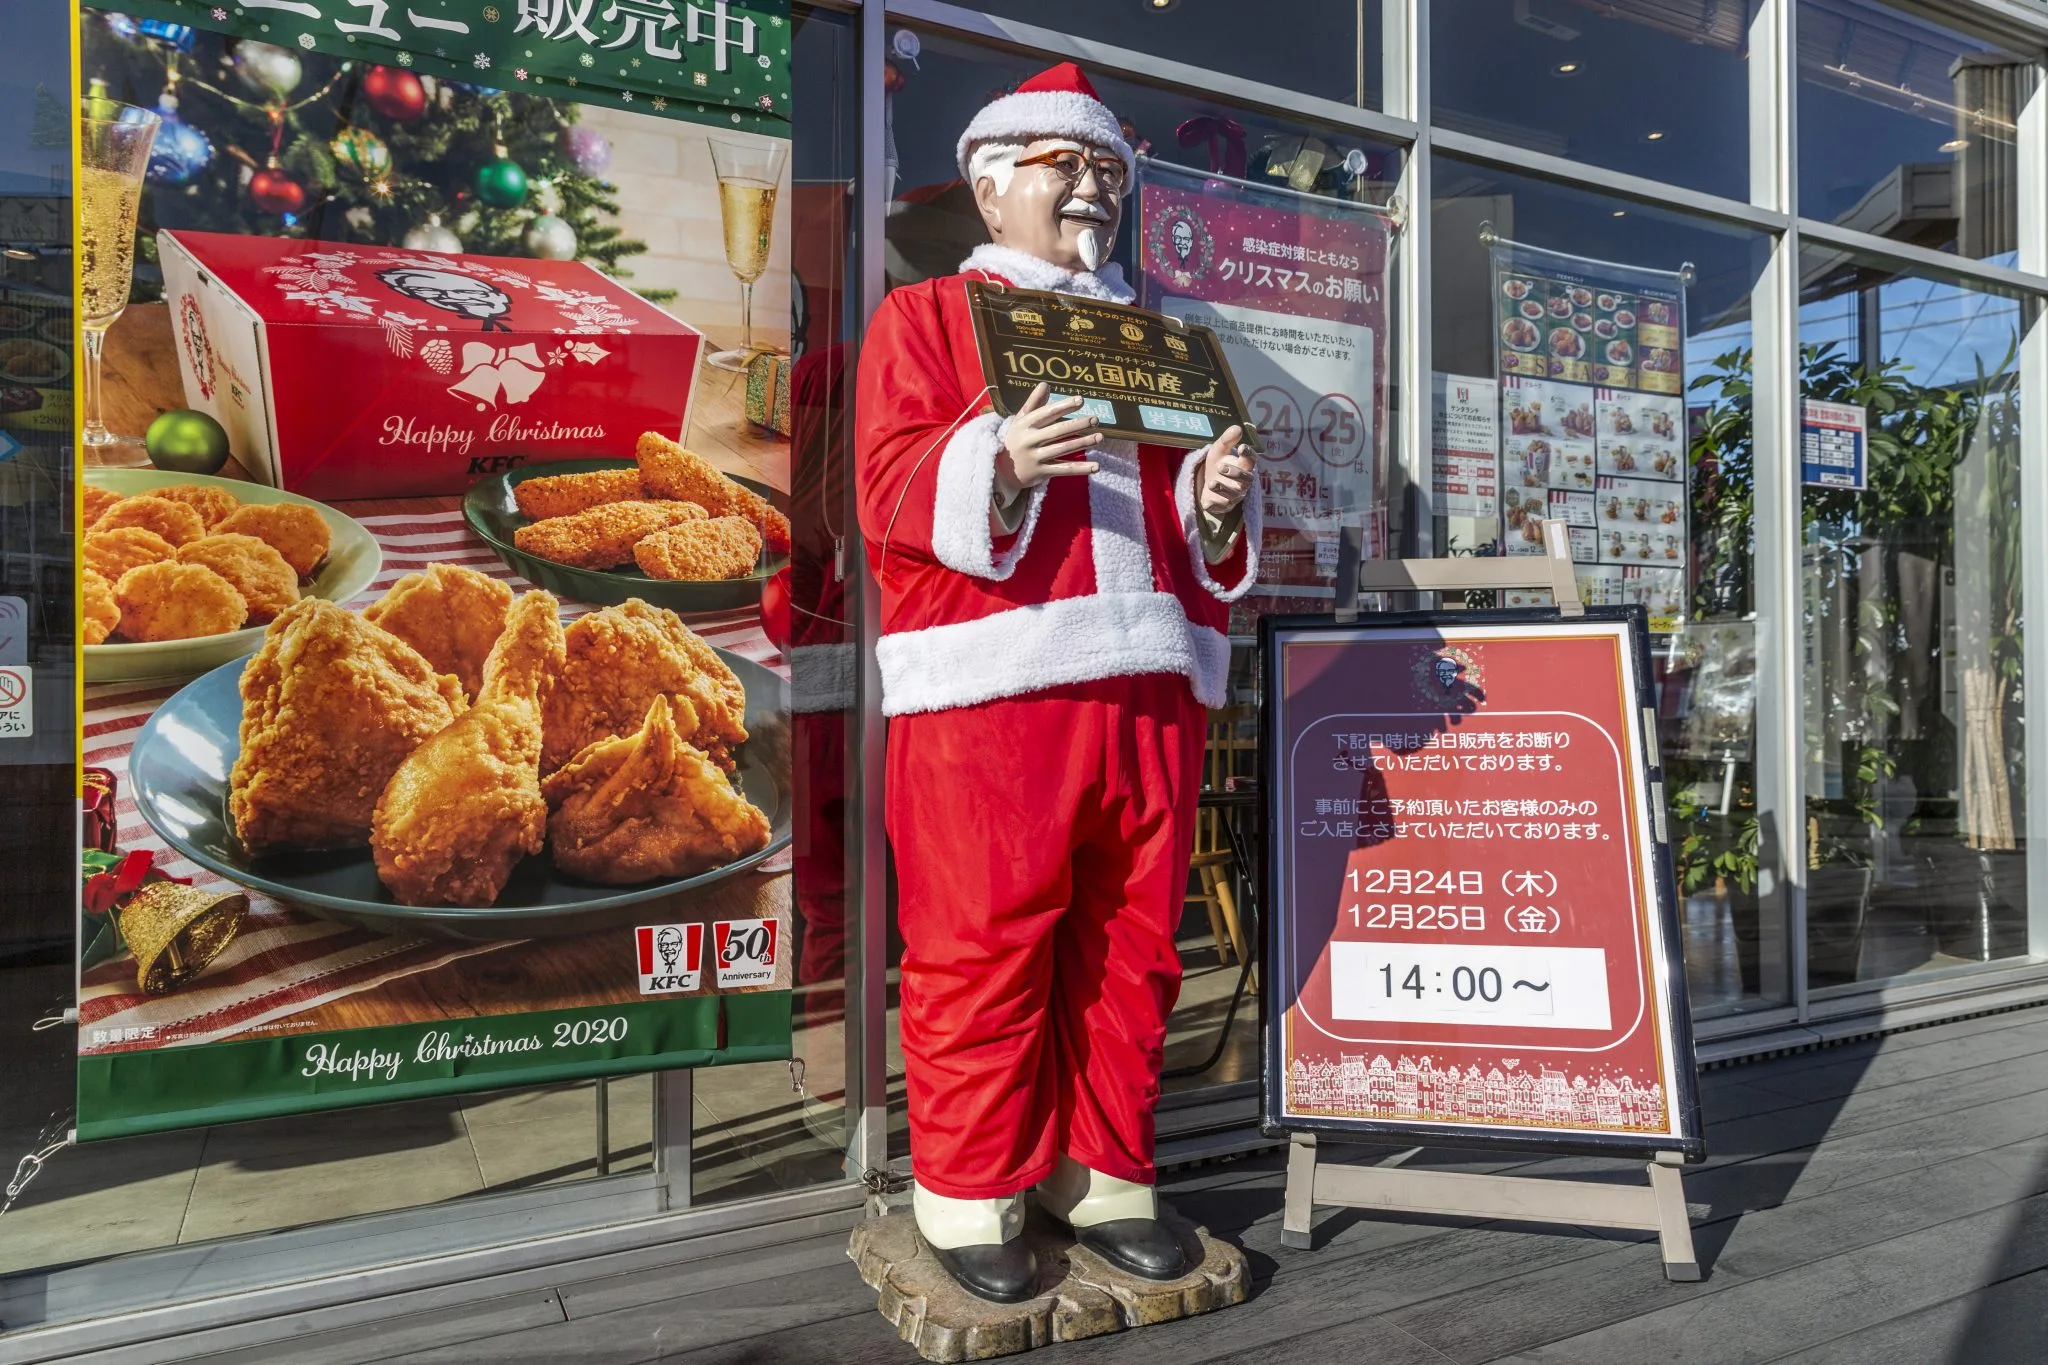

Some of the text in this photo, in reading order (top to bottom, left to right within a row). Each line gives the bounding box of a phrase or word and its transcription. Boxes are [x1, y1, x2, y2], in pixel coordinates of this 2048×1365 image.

[1242, 237, 1360, 271] 感染症対策にともなう
[1218, 257, 1380, 304] クリスマスのお願い
[1184, 312, 1356, 348] 例年以上に商品提供にお時間をいただいたり、
[1068, 348, 1157, 368] ケンタッキーのチキンは
[1003, 351, 1185, 396] 100%国内産
[1149, 410, 1206, 432] 岩手県
[1256, 401, 1294, 439] 24
[1319, 408, 1356, 445] 25
[378, 413, 607, 455] Happy Christmas
[1331, 732, 1571, 752] 下記日時は当日販売をお断り
[1332, 754, 1564, 772] させていただいております。
[1315, 797, 1598, 817] 事前にご予約頂いたお客様のみの
[1300, 821, 1611, 841] ご入店とさせていただいております。
[1347, 869, 1484, 896] 12月24日
[1348, 904, 1486, 932] 12月25日
[649, 974, 692, 991] KFC
[722, 971, 772, 981] Anniversary
[92, 1026, 156, 1044] 数量限定
[301, 1016, 628, 1082] Happy Christmas 2020
